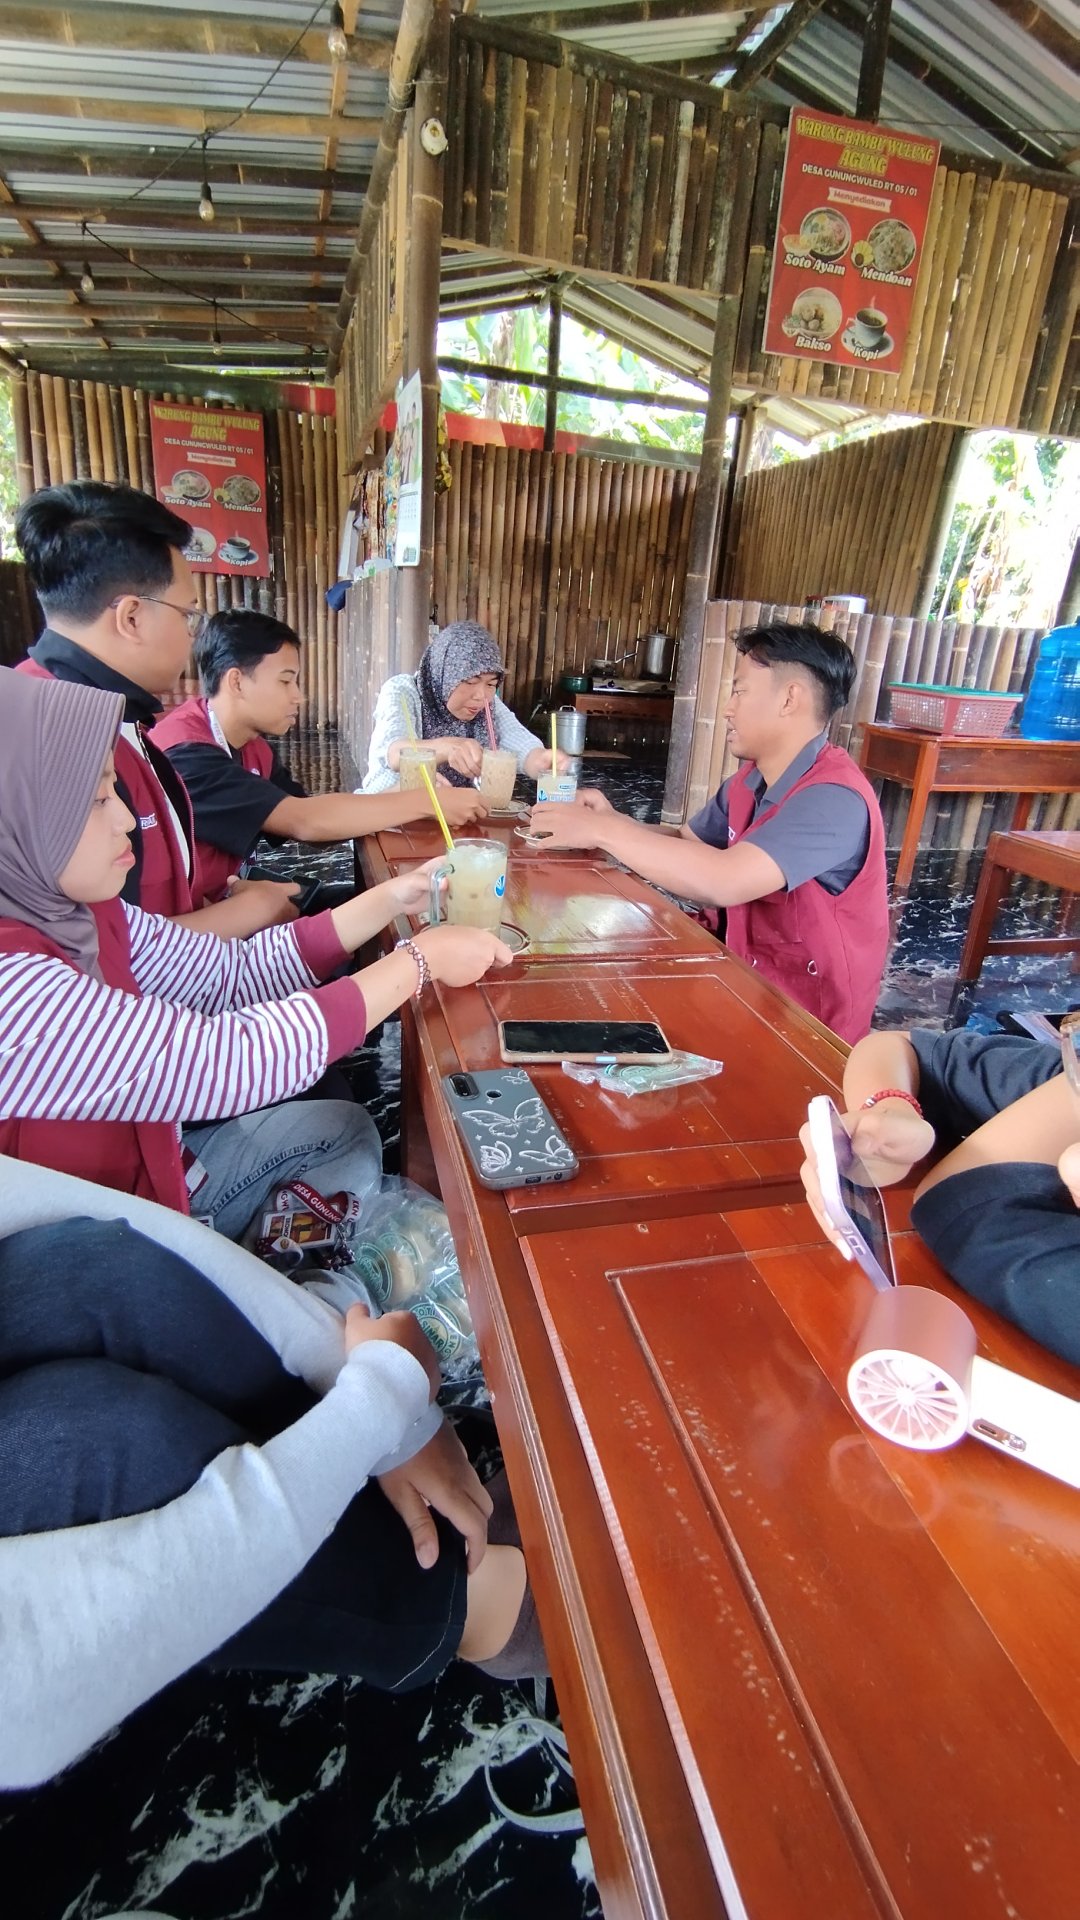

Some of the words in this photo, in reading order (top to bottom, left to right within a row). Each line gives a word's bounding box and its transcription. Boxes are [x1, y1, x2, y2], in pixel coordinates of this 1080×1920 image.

[797, 116, 844, 143] WARUNG
[844, 129, 887, 152] BAMBU
[886, 137, 935, 165] WULUNG
[838, 147, 888, 176] AGUNG
[802, 163, 823, 177] DESA
[824, 170, 883, 190] GUNUNGWULED
[884, 182, 894, 191] RT
[833, 189, 886, 208] Menyediakan
[784, 253, 812, 269] Soto
[812, 260, 846, 276] Ayam
[860, 266, 913, 287] Mendoan
[795, 335, 832, 352] Bakso
[854, 345, 879, 361] Kopi
[165, 496, 186, 505] Soto
[186, 498, 211, 509] Ayam
[223, 502, 262, 513] Mendoan
[185, 554, 213, 563] Bakso
[230, 558, 249, 567] Kopi
[293, 1183, 311, 1200] DESA
[421, 1320, 445, 1350] SINAR
